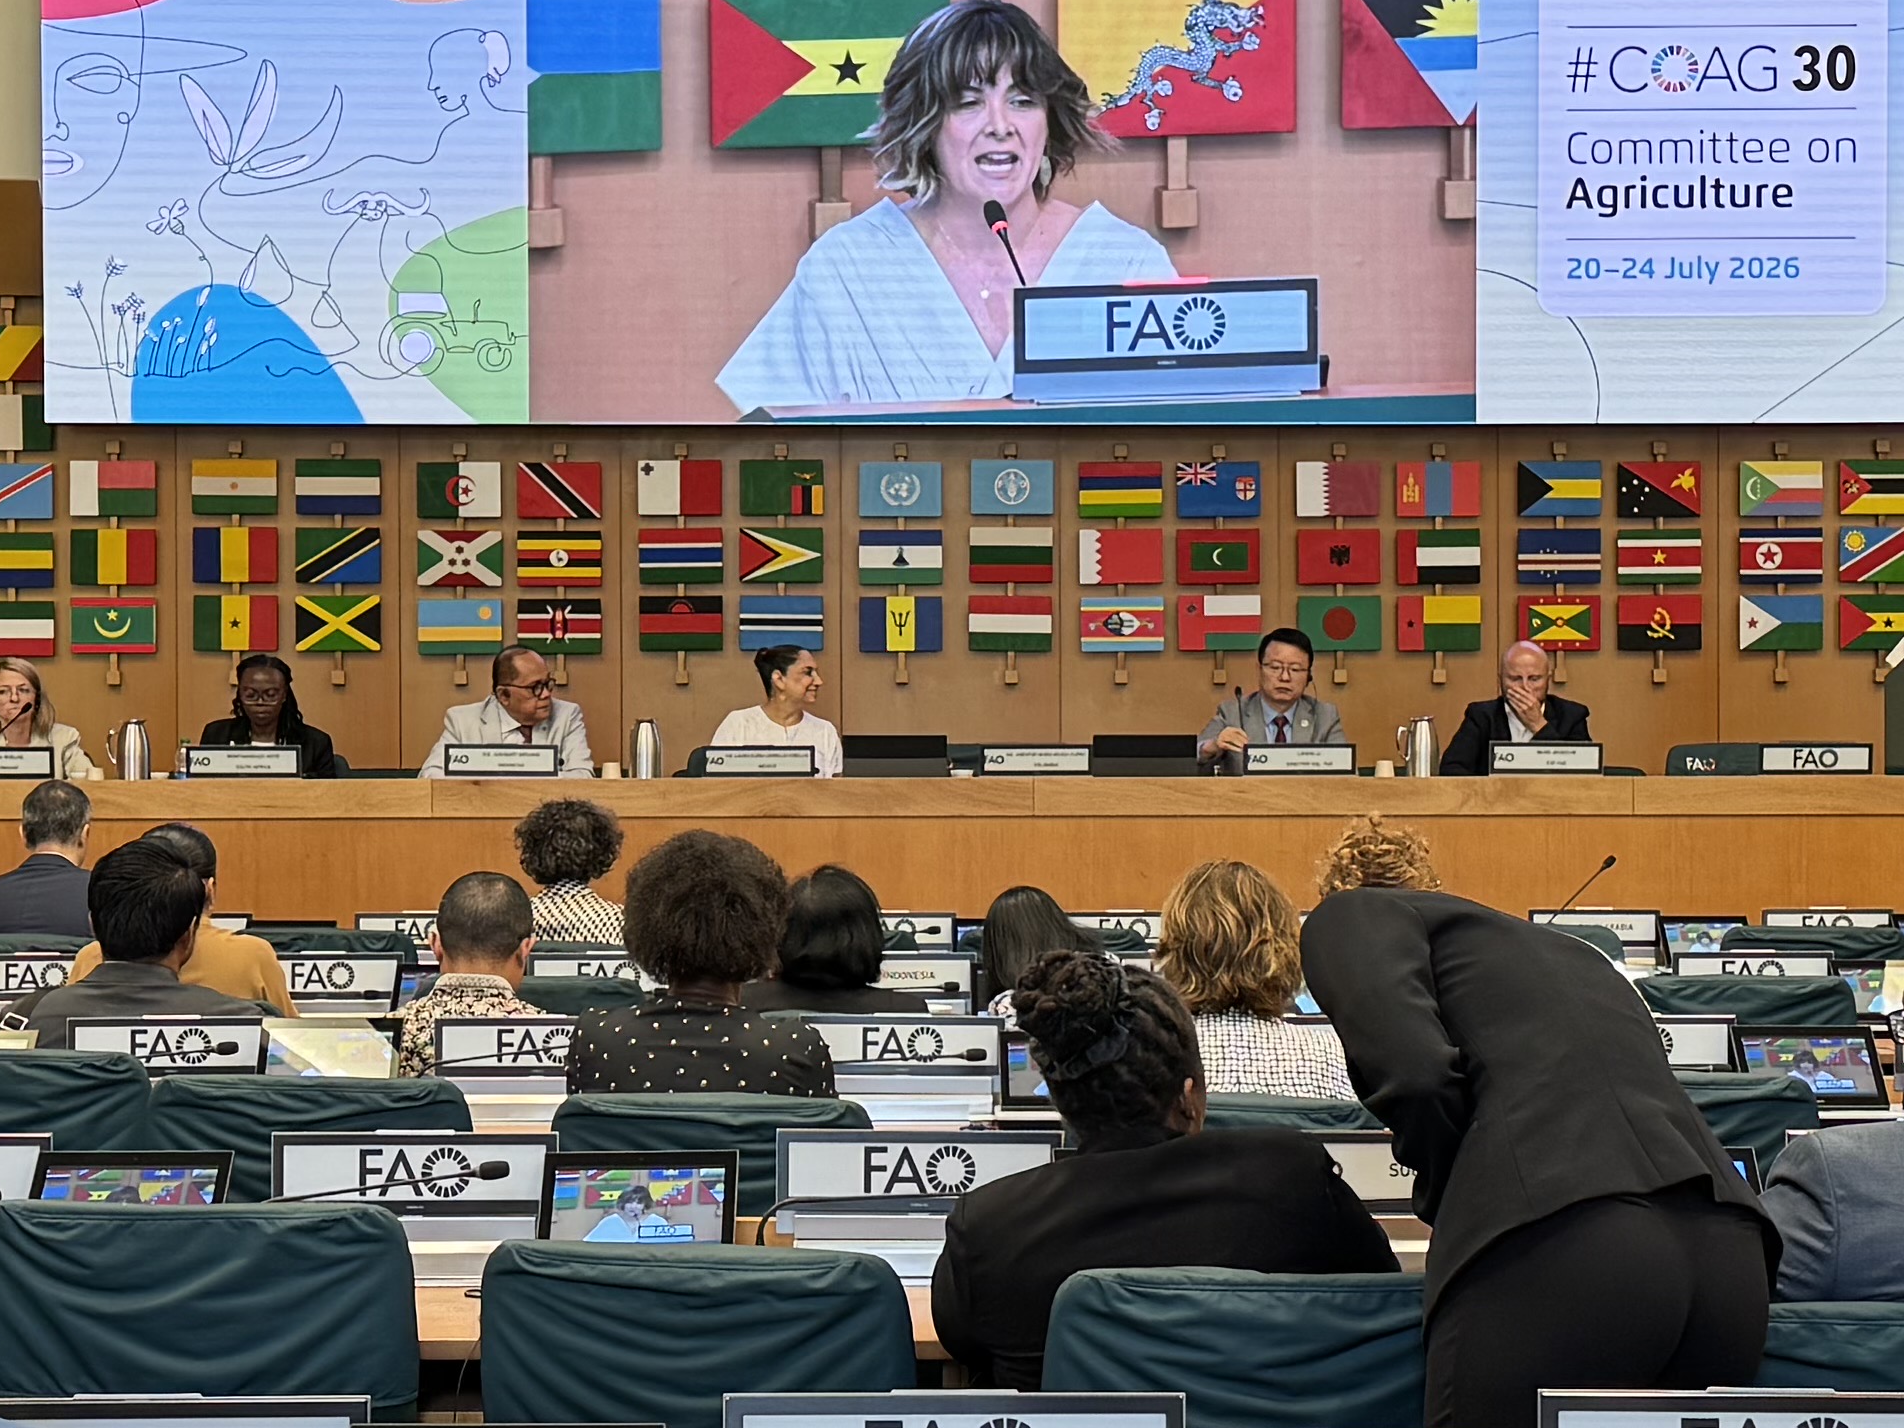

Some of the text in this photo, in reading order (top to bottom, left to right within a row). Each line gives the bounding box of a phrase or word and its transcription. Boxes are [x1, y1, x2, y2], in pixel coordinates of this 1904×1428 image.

[1567, 129, 1857, 165] Committee on
[1566, 175, 1794, 218] Agriculture
[1664, 255, 1720, 285] July
[1729, 256, 1801, 279] 2026
[1106, 295, 1227, 352] FAO
[1793, 749, 1839, 769] FAO
[5, 961, 70, 990] FAO
[291, 960, 356, 991] FAO
[130, 1028, 213, 1065] FAO
[497, 1028, 571, 1064] FAO
[862, 1026, 944, 1063] FAO
[359, 1147, 473, 1198] FAO
[863, 1145, 977, 1194] FAO
